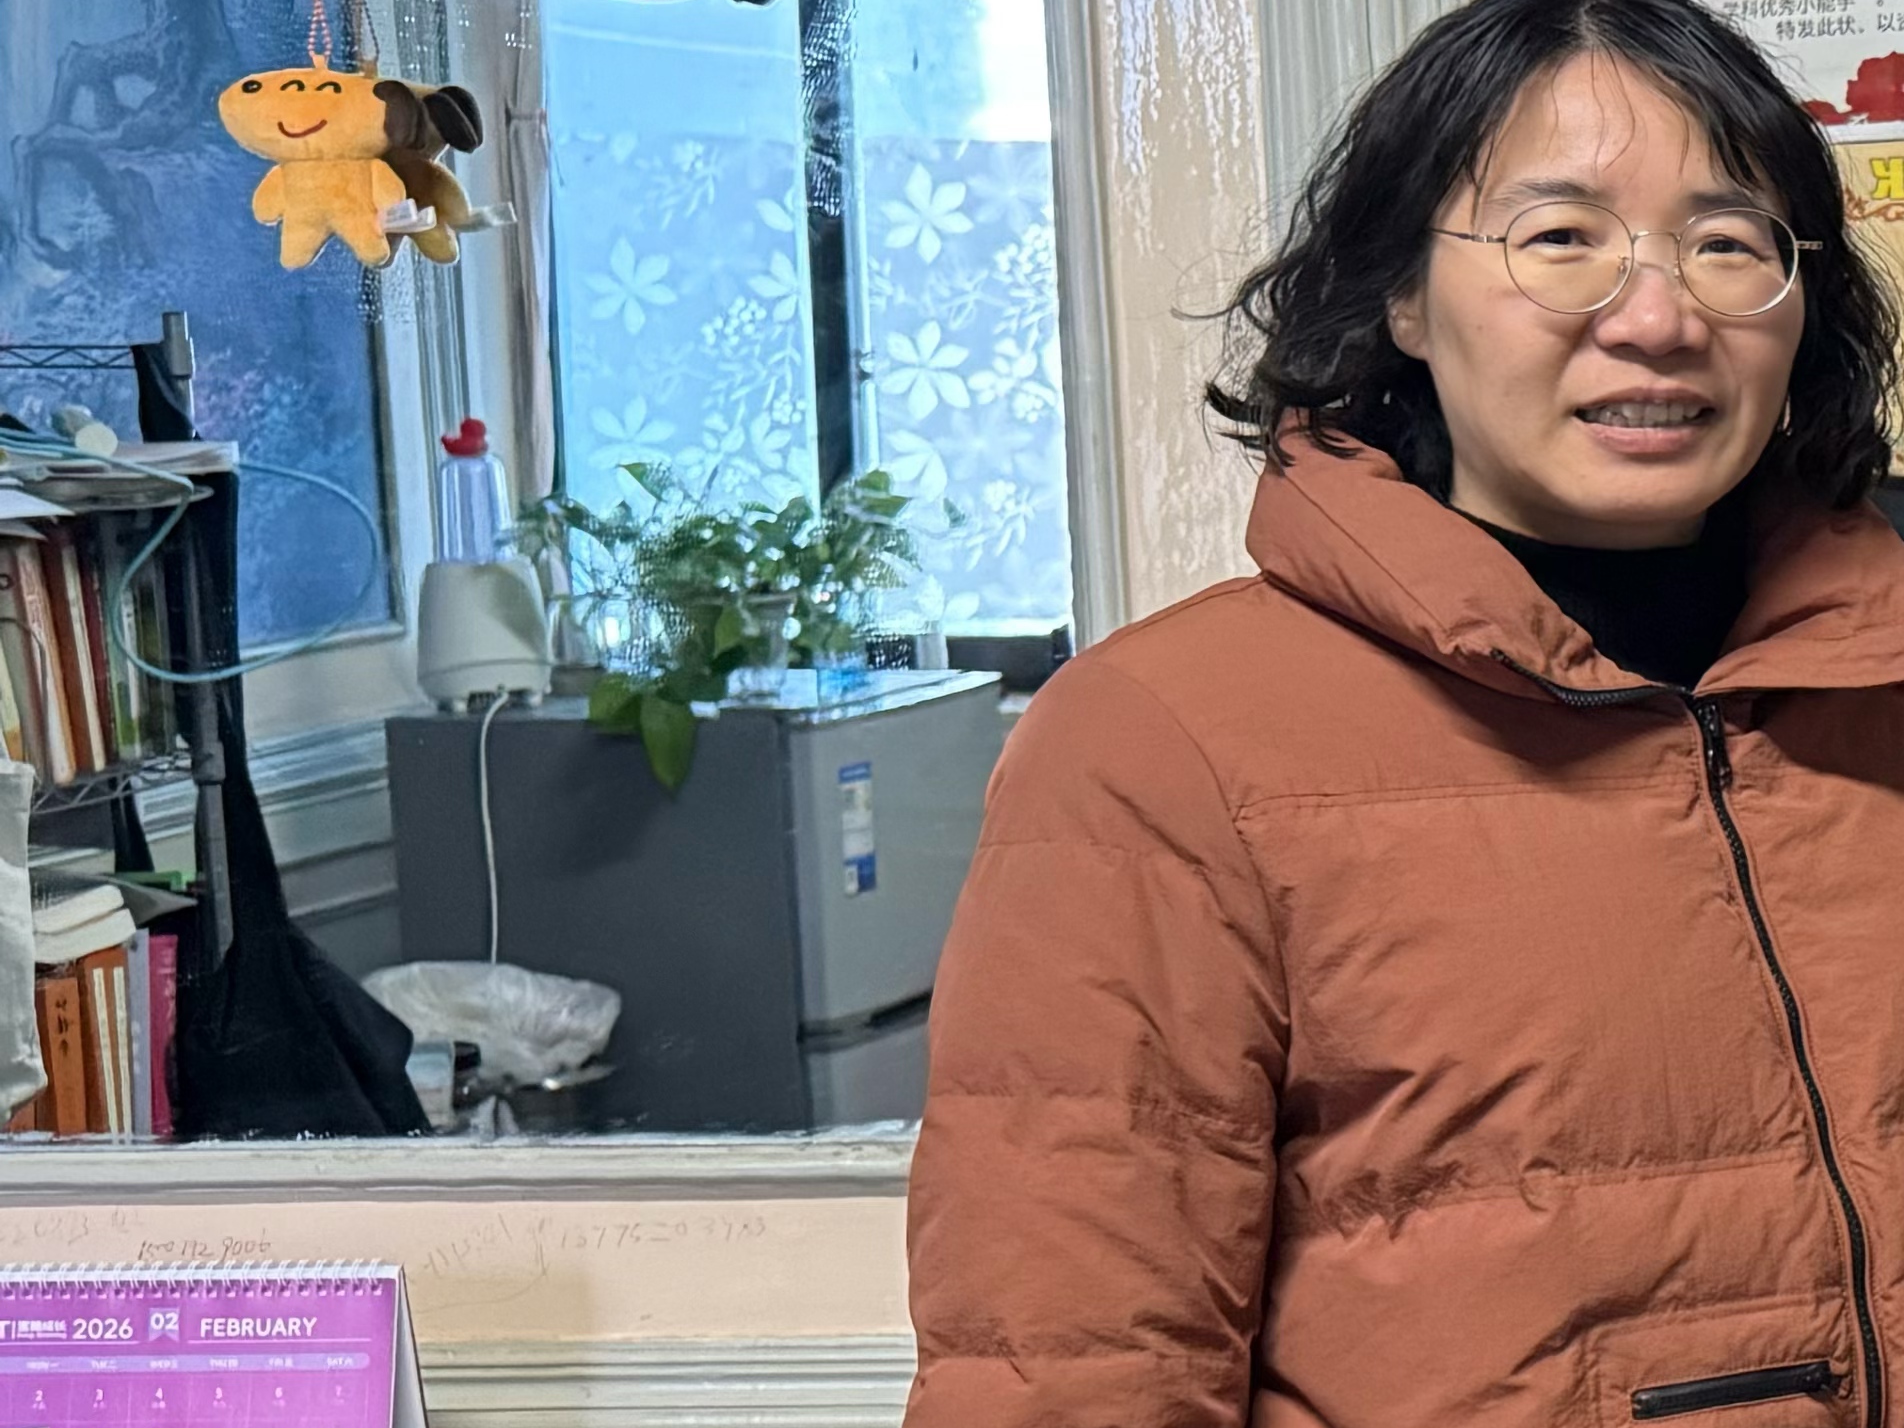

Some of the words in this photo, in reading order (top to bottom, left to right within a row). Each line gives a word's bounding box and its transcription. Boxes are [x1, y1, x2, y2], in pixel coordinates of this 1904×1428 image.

[72, 1318, 134, 1340] 2026
[151, 1312, 179, 1330] 02
[200, 1317, 318, 1338] FEBRUARY
